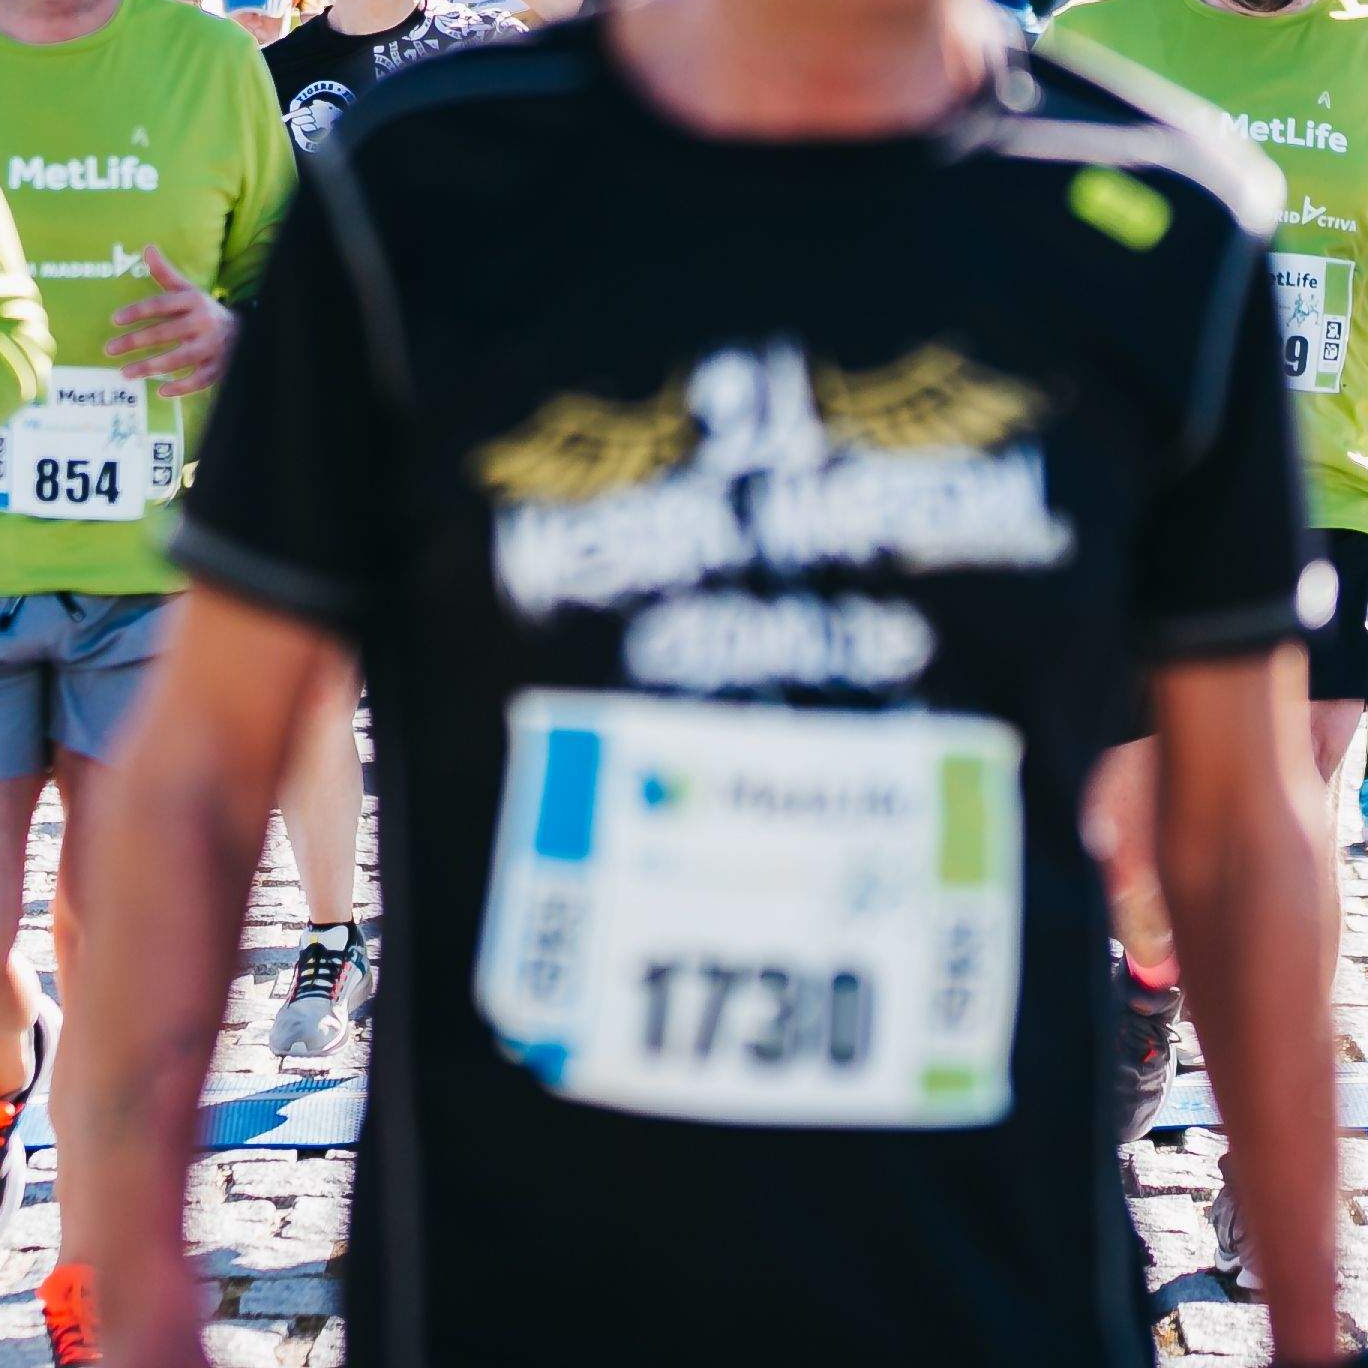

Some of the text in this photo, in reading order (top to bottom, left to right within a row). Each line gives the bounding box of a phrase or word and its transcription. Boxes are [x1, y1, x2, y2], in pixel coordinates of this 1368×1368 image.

[9, 156, 159, 190] MetLife
[1285, 335, 1309, 377] 9
[34, 458, 120, 506] 854
